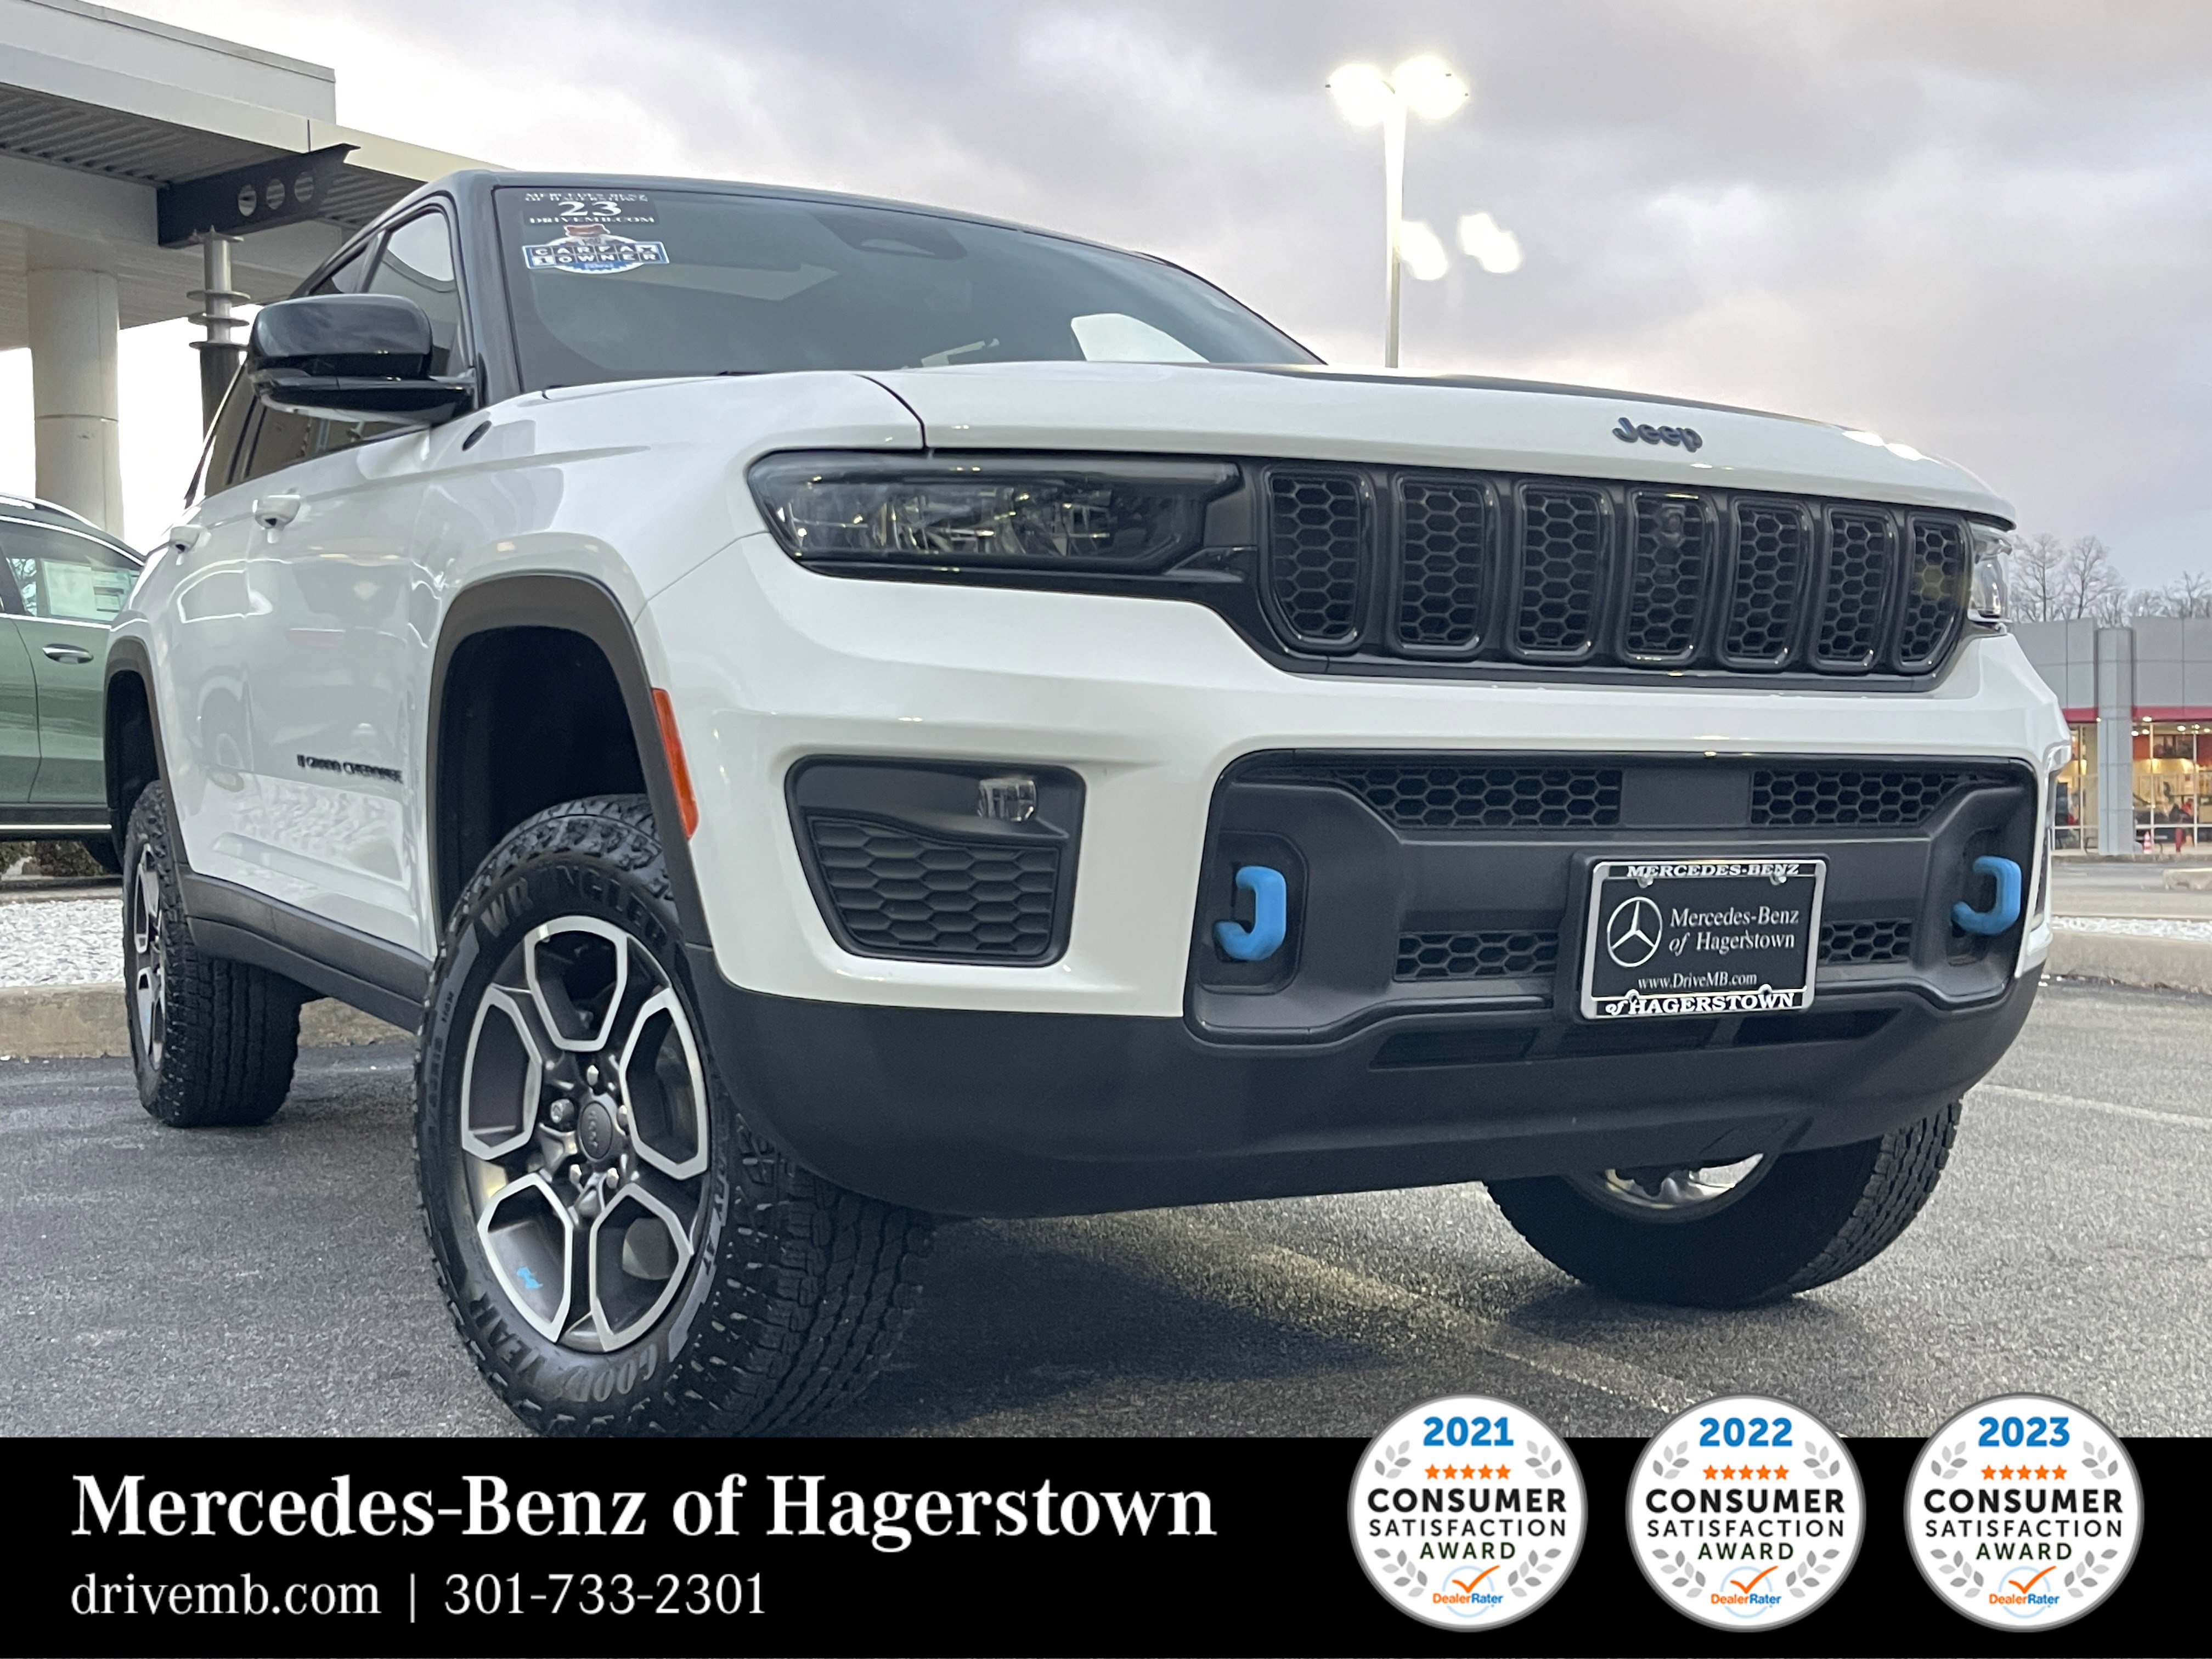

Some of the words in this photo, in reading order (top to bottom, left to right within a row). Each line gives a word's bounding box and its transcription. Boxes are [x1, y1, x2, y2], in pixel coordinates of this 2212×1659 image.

[557, 201, 622, 216] 23
[535, 245, 653, 256] CARFAX
[558, 254, 657, 263] OWNER
[1612, 417, 1703, 453] Jeep
[1626, 864, 1800, 878] MERCEDES-BENZ
[481, 865, 668, 947] WRNGLER
[1669, 906, 1799, 928] Mercedes-Benz
[1668, 932, 1691, 957] of
[1696, 929, 1795, 955] Hagerstown
[1638, 971, 1758, 990] www.DriveMB.com
[1605, 998, 1627, 1016] of
[1628, 992, 1795, 1015] HAGERSTOWN
